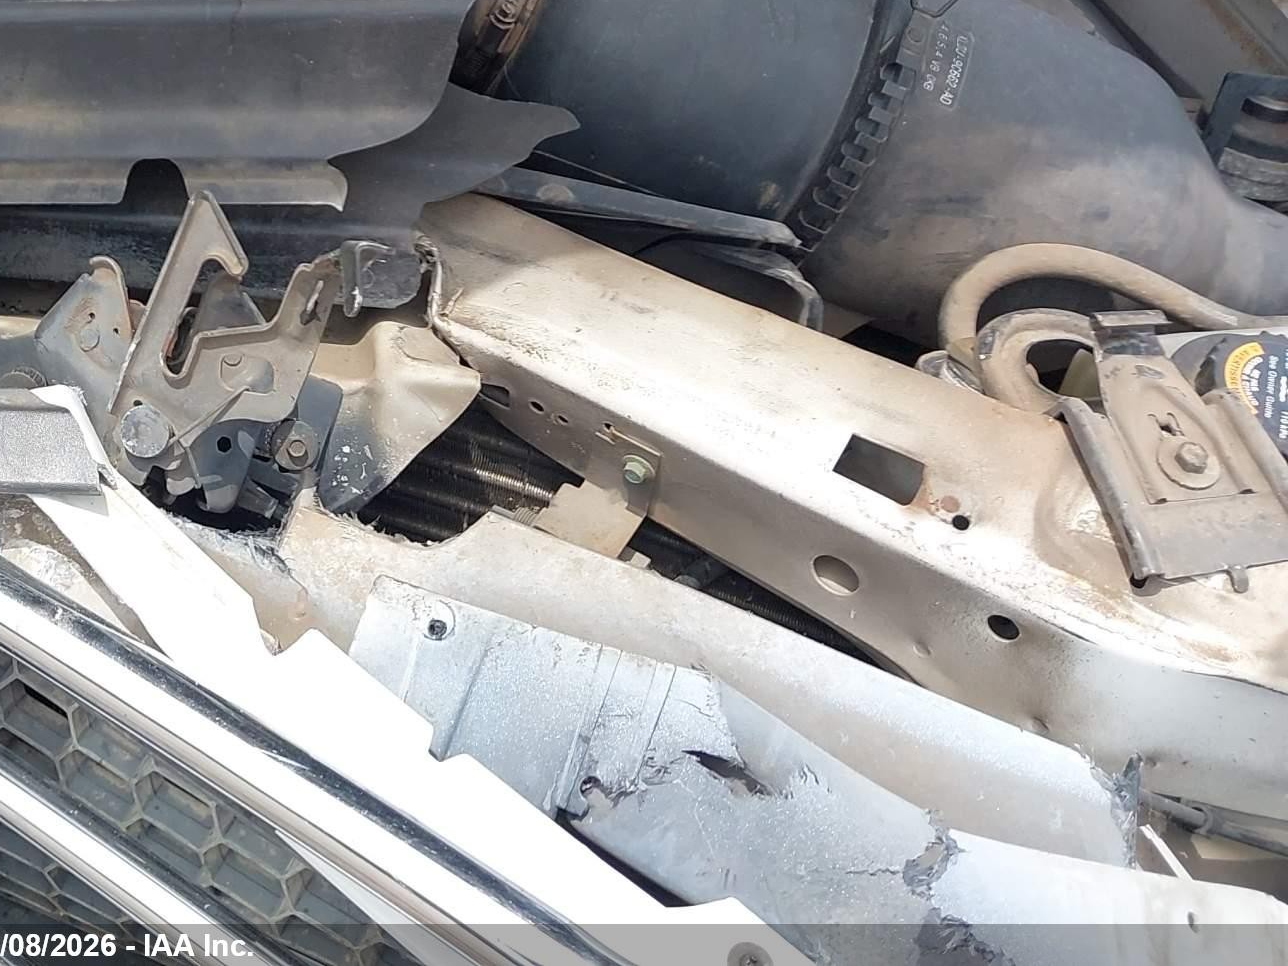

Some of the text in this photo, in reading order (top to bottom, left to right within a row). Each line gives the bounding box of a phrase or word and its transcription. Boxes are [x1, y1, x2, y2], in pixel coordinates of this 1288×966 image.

[1264, 355, 1279, 418] See Owner Guide
